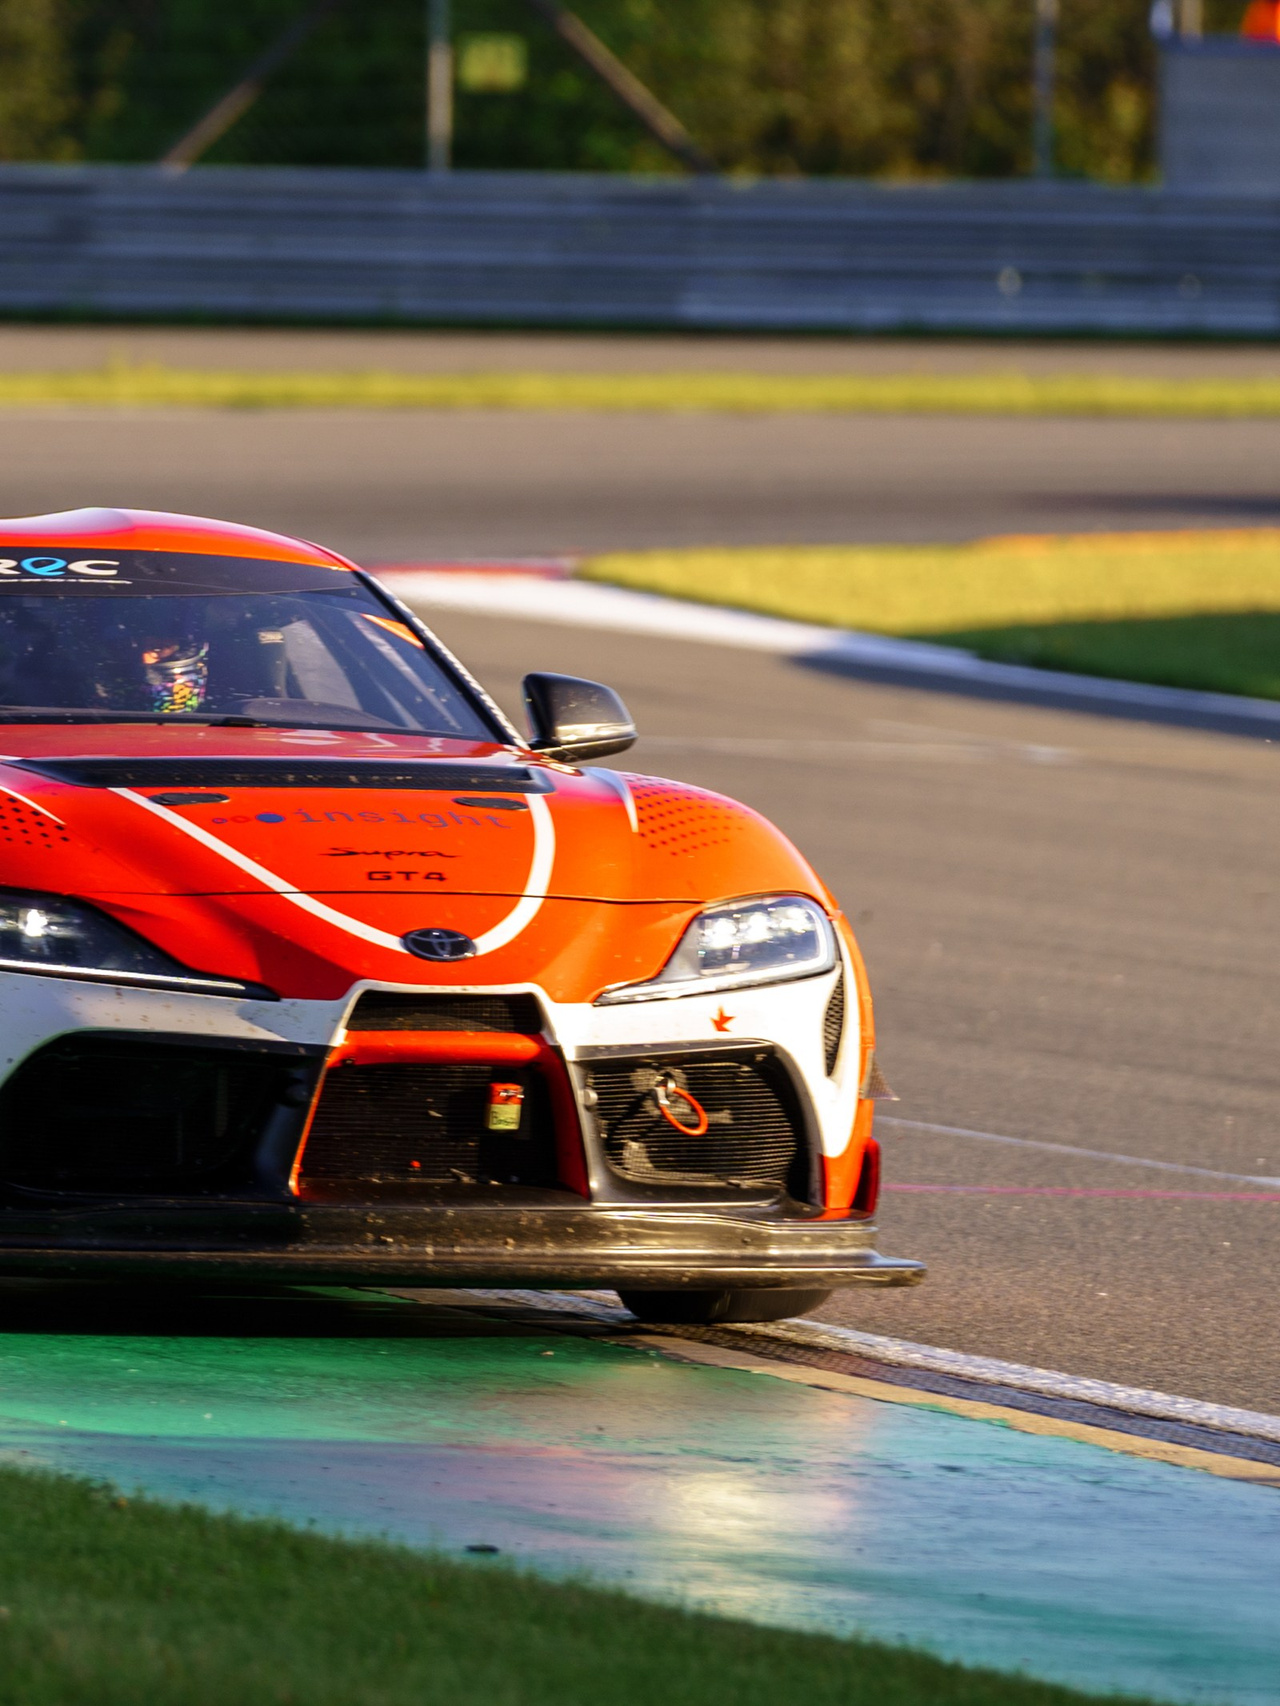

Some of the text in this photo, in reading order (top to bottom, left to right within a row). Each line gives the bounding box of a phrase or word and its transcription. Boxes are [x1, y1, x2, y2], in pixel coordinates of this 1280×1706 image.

[293, 808, 512, 829] insight
[321, 847, 457, 860] Supra
[366, 870, 448, 882] GT4
